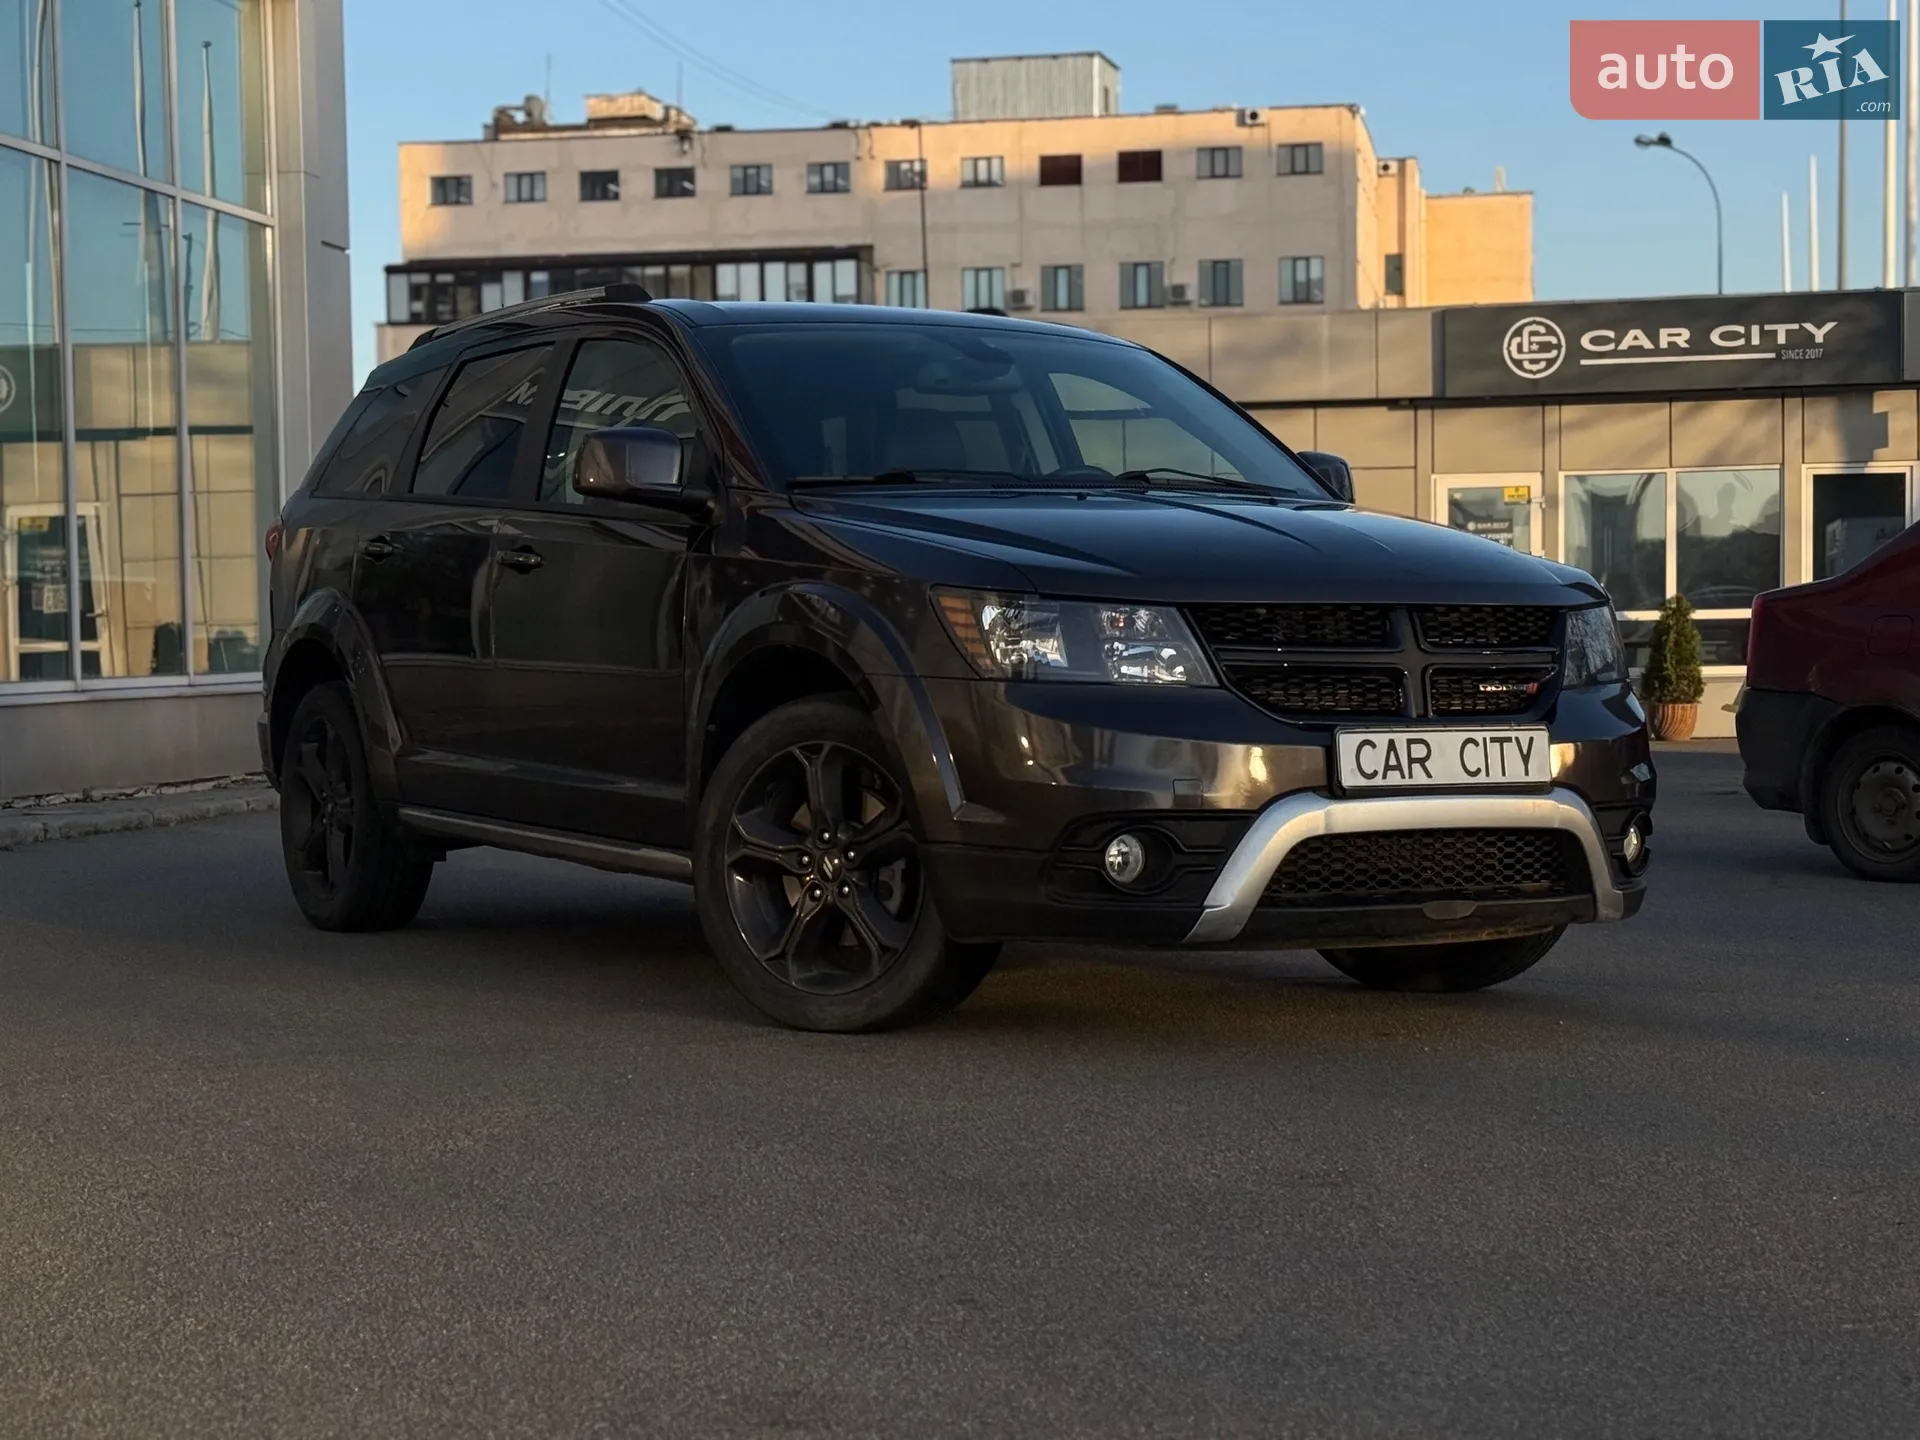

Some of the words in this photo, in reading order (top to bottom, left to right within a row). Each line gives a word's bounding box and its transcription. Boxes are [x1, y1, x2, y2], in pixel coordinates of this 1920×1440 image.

[1580, 327, 1691, 352] CAR
[1709, 321, 1839, 347] CITY
[1780, 349, 1804, 360] SINCE
[1805, 348, 1824, 359] 2017
[1355, 738, 1433, 780] CAR
[1459, 736, 1535, 778] CITY
